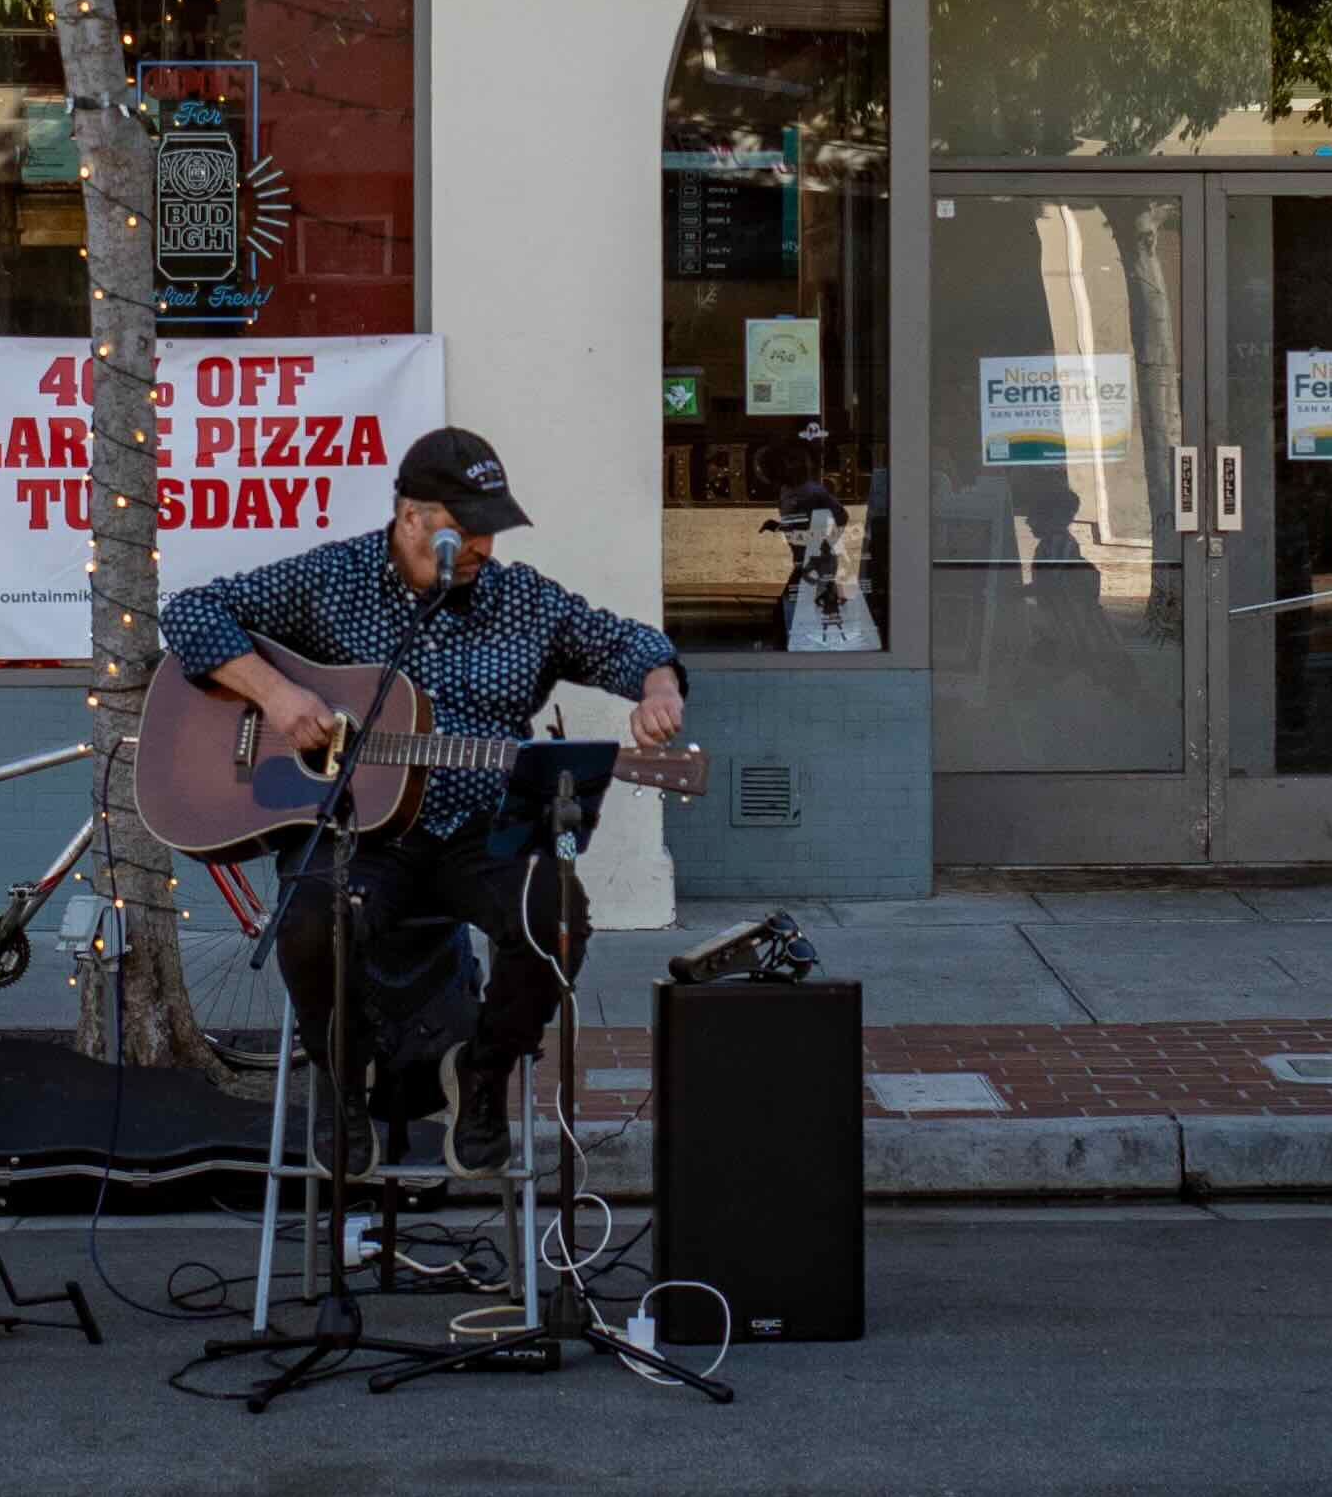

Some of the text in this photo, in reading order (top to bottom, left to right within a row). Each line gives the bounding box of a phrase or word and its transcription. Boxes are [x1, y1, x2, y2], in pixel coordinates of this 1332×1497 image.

[165, 203, 233, 229] BUD
[195, 354, 315, 408] OFF
[194, 414, 389, 468] PIZZA
[16, 476, 332, 531] TUSDAY!
